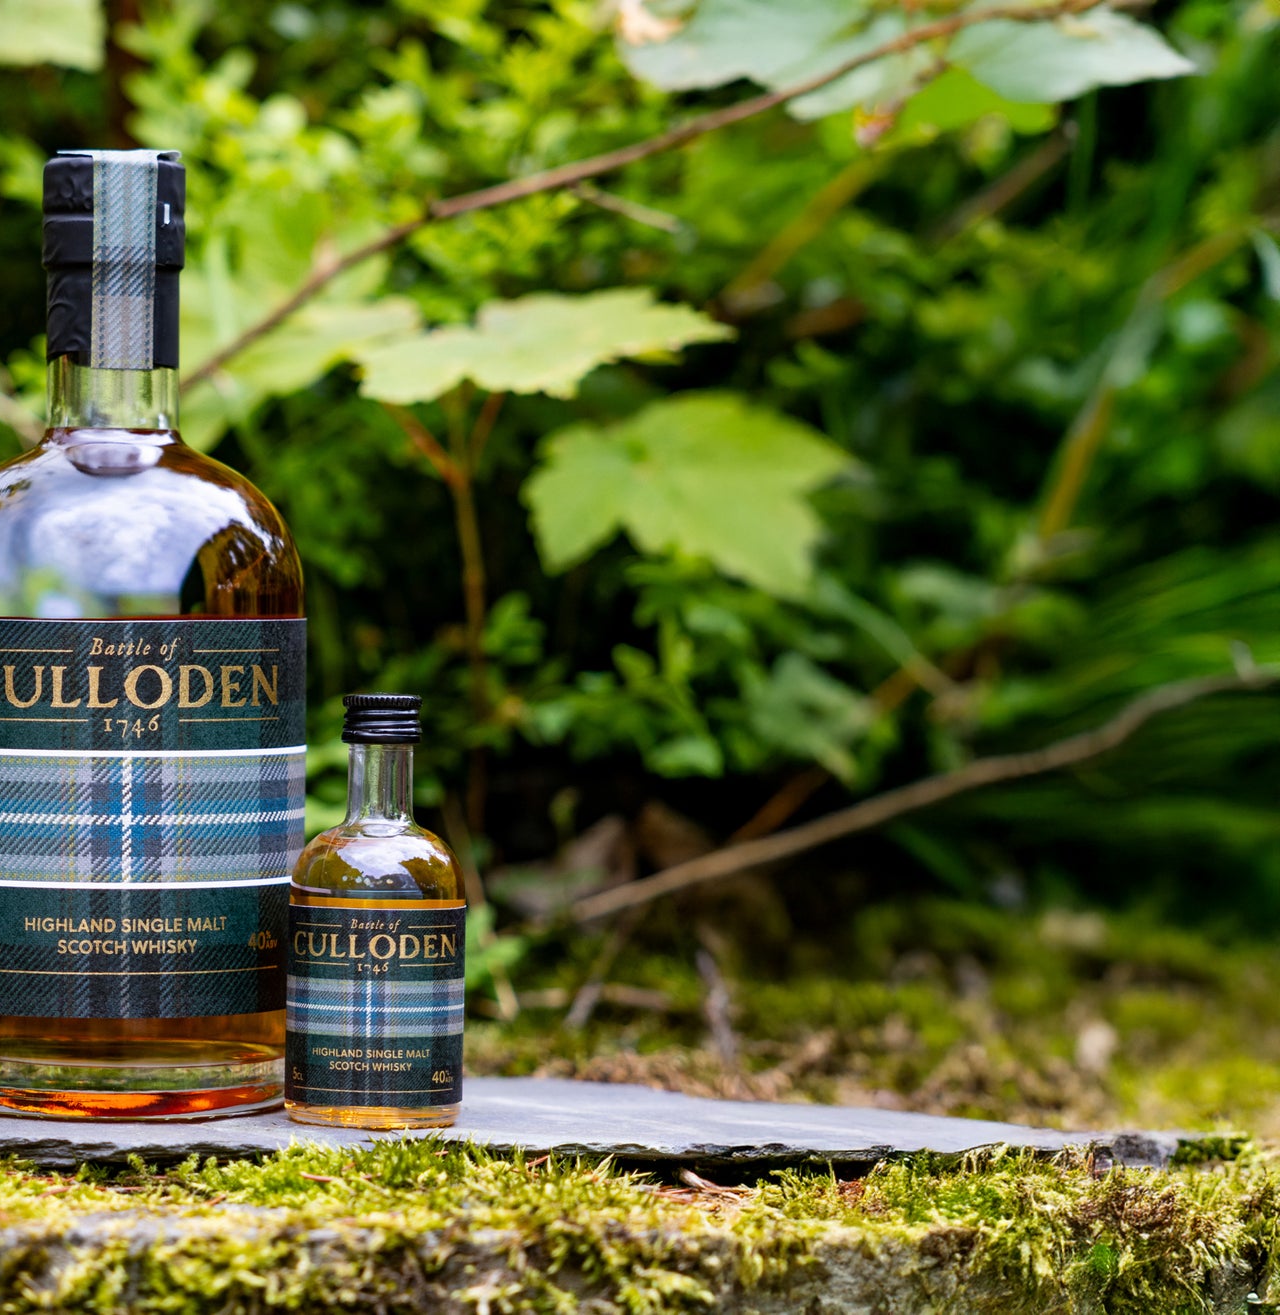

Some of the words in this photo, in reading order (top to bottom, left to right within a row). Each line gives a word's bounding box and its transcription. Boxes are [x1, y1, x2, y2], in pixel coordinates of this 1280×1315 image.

[90, 638, 151, 656] Battle
[160, 637, 181, 661] of
[103, 713, 160, 739] 1746
[24, 917, 117, 933] HIGHLAND
[120, 917, 182, 933] SINGLE
[187, 916, 227, 932] MALT
[351, 918, 385, 930] Battle
[389, 919, 401, 933] of
[57, 939, 128, 955] SCOTCH
[131, 939, 198, 955] WHISKY
[294, 931, 456, 960] CULLODEN
[312, 1047, 364, 1058] HIGHLAND
[366, 1049, 403, 1059] SINGLE
[405, 1048, 431, 1058] MALT
[329, 1062, 370, 1072] SCOTCH
[372, 1062, 413, 1072] WHISKY
